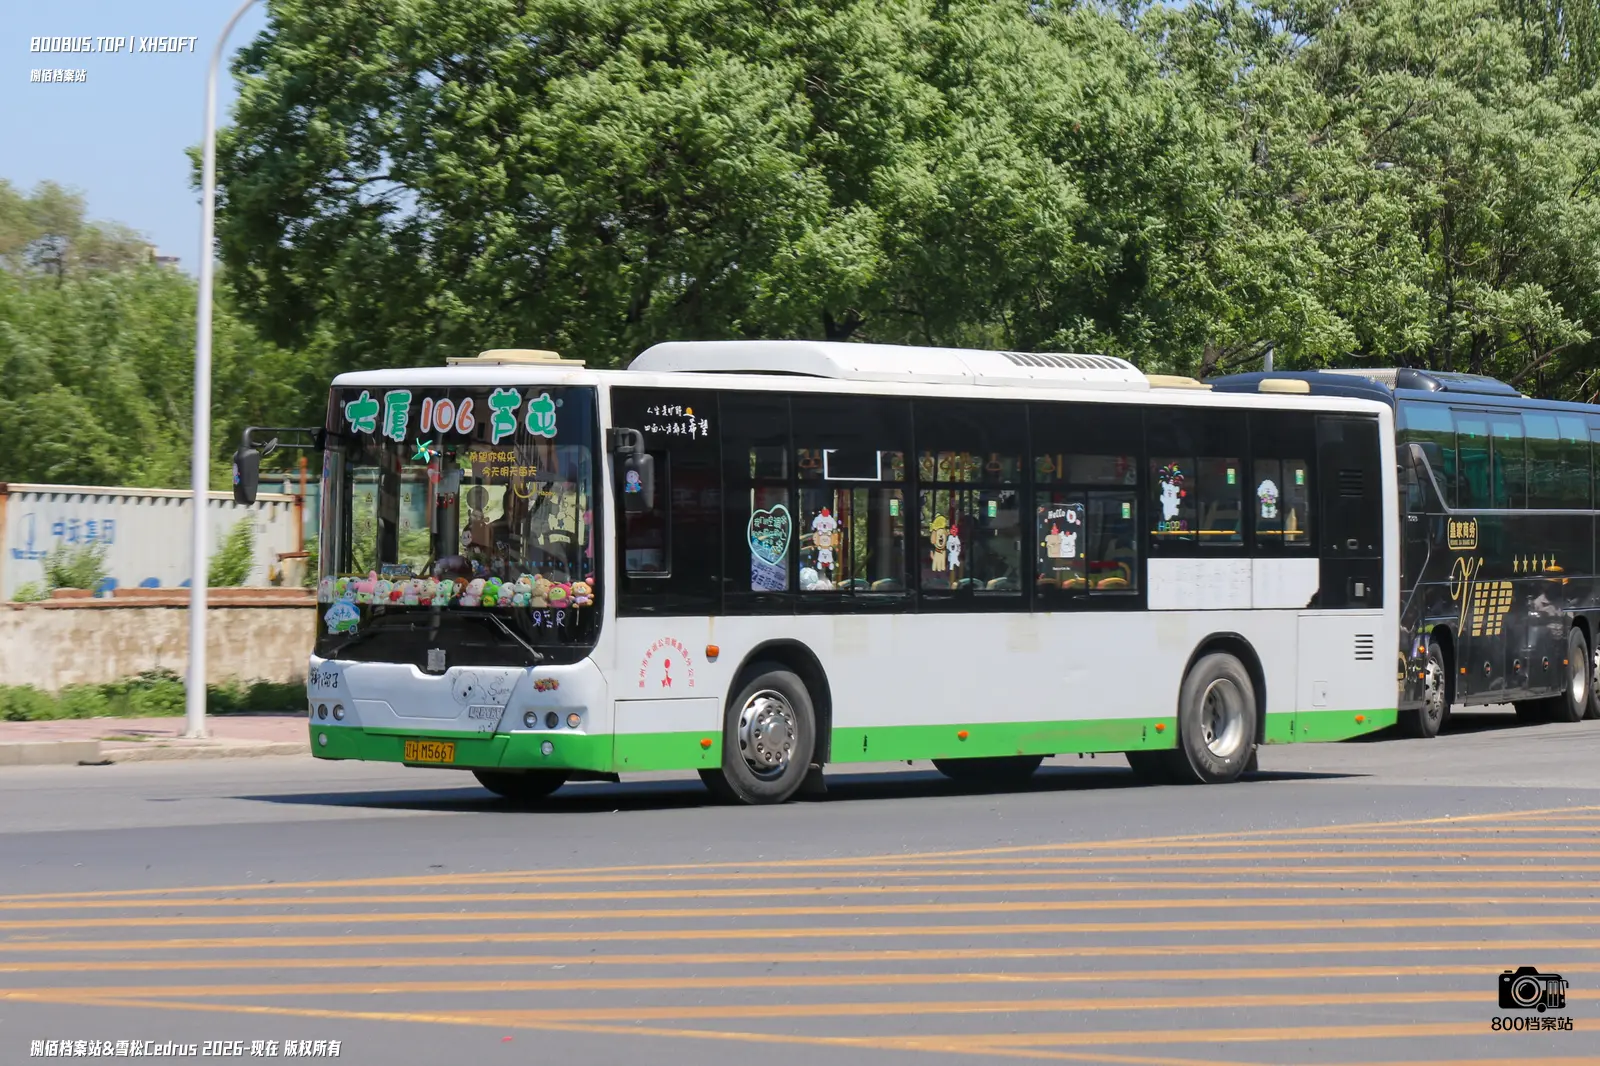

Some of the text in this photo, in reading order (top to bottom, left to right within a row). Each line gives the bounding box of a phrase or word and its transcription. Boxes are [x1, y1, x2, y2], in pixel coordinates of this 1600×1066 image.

[345, 387, 558, 446] 大厦 106 芦屯
[468, 450, 517, 463] 希望你快乐
[1450, 521, 1476, 539] 皇家商务
